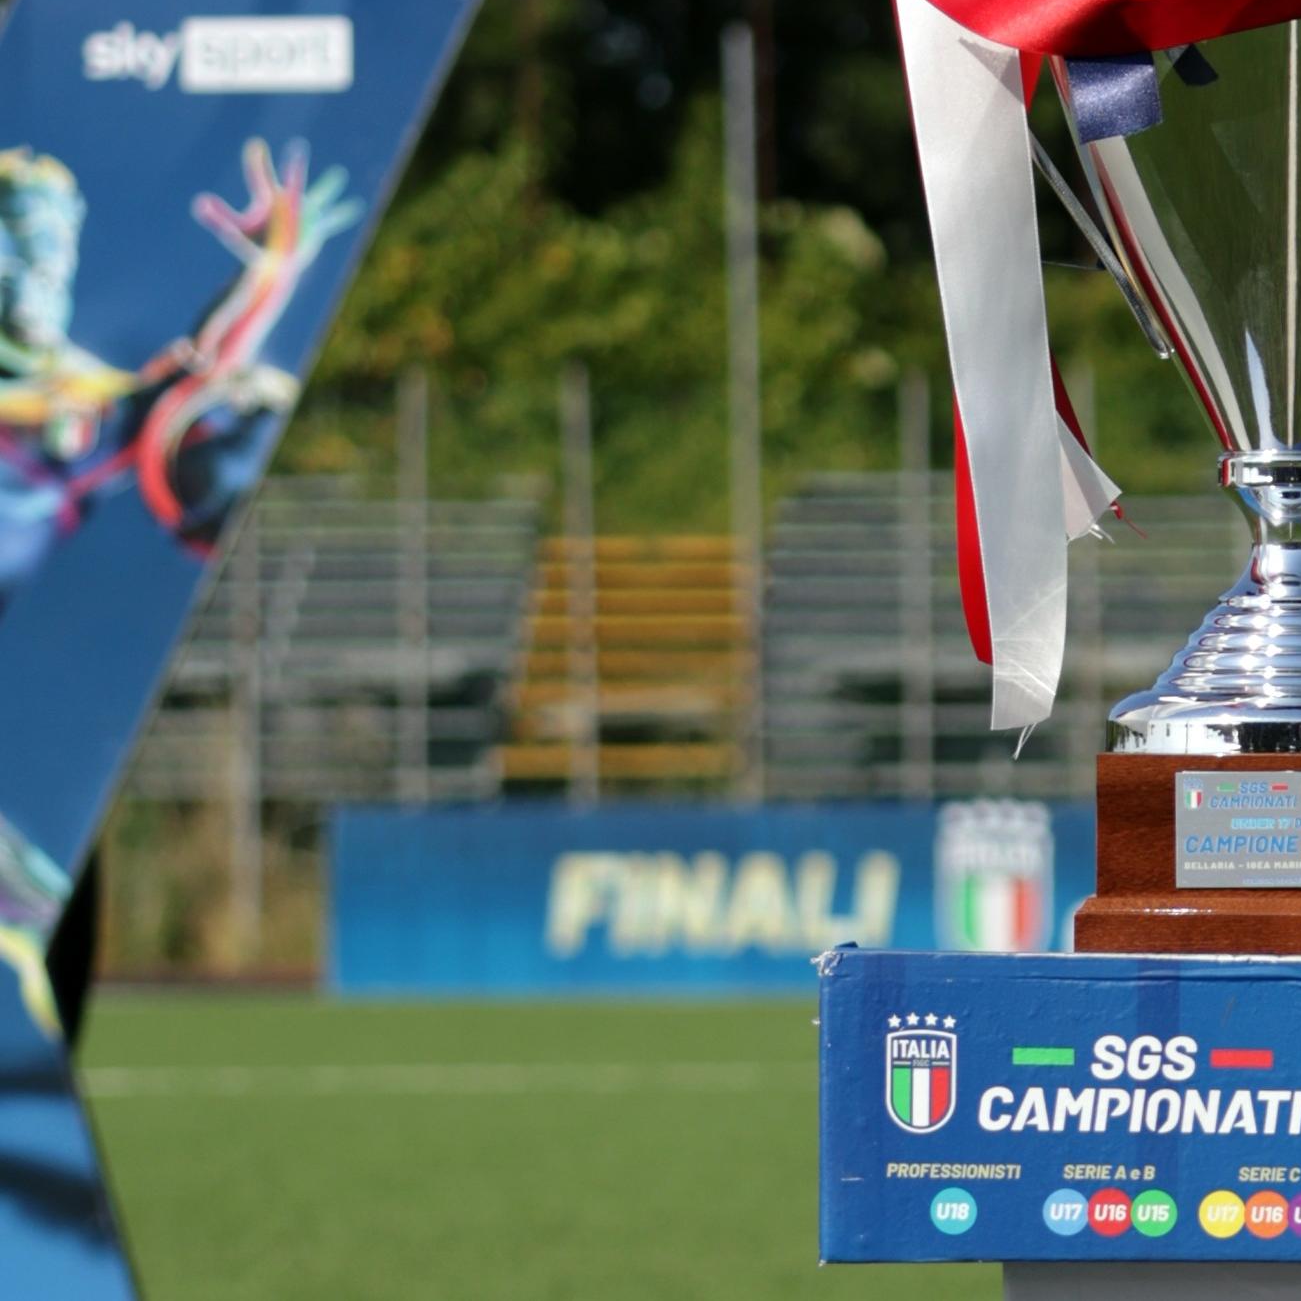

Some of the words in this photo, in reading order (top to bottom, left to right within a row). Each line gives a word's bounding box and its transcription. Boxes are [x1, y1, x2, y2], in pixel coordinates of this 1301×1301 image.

[82, 19, 181, 92] sky
[1239, 782, 1268, 794] SGS
[1209, 795, 1297, 809] CAMPIONATI
[1185, 835, 1298, 854] CAMPIONE
[545, 849, 901, 959] FINALI
[893, 1039, 950, 1059] ITALIA
[1090, 1035, 1198, 1081] SGS
[886, 1162, 1021, 1180] PROFESSIONISTI
[1063, 1164, 1112, 1180] SERIE
[1114, 1165, 1127, 1180] A
[1143, 1165, 1156, 1180] B
[1238, 1167, 1288, 1183] SERIE
[1289, 1168, 1301, 1183] C
[936, 1202, 969, 1220] U18
[1049, 1203, 1082, 1221] U17
[1093, 1204, 1127, 1221] U16
[1137, 1204, 1170, 1221] U15
[1206, 1205, 1239, 1222] U17
[1250, 1205, 1284, 1223] U16
